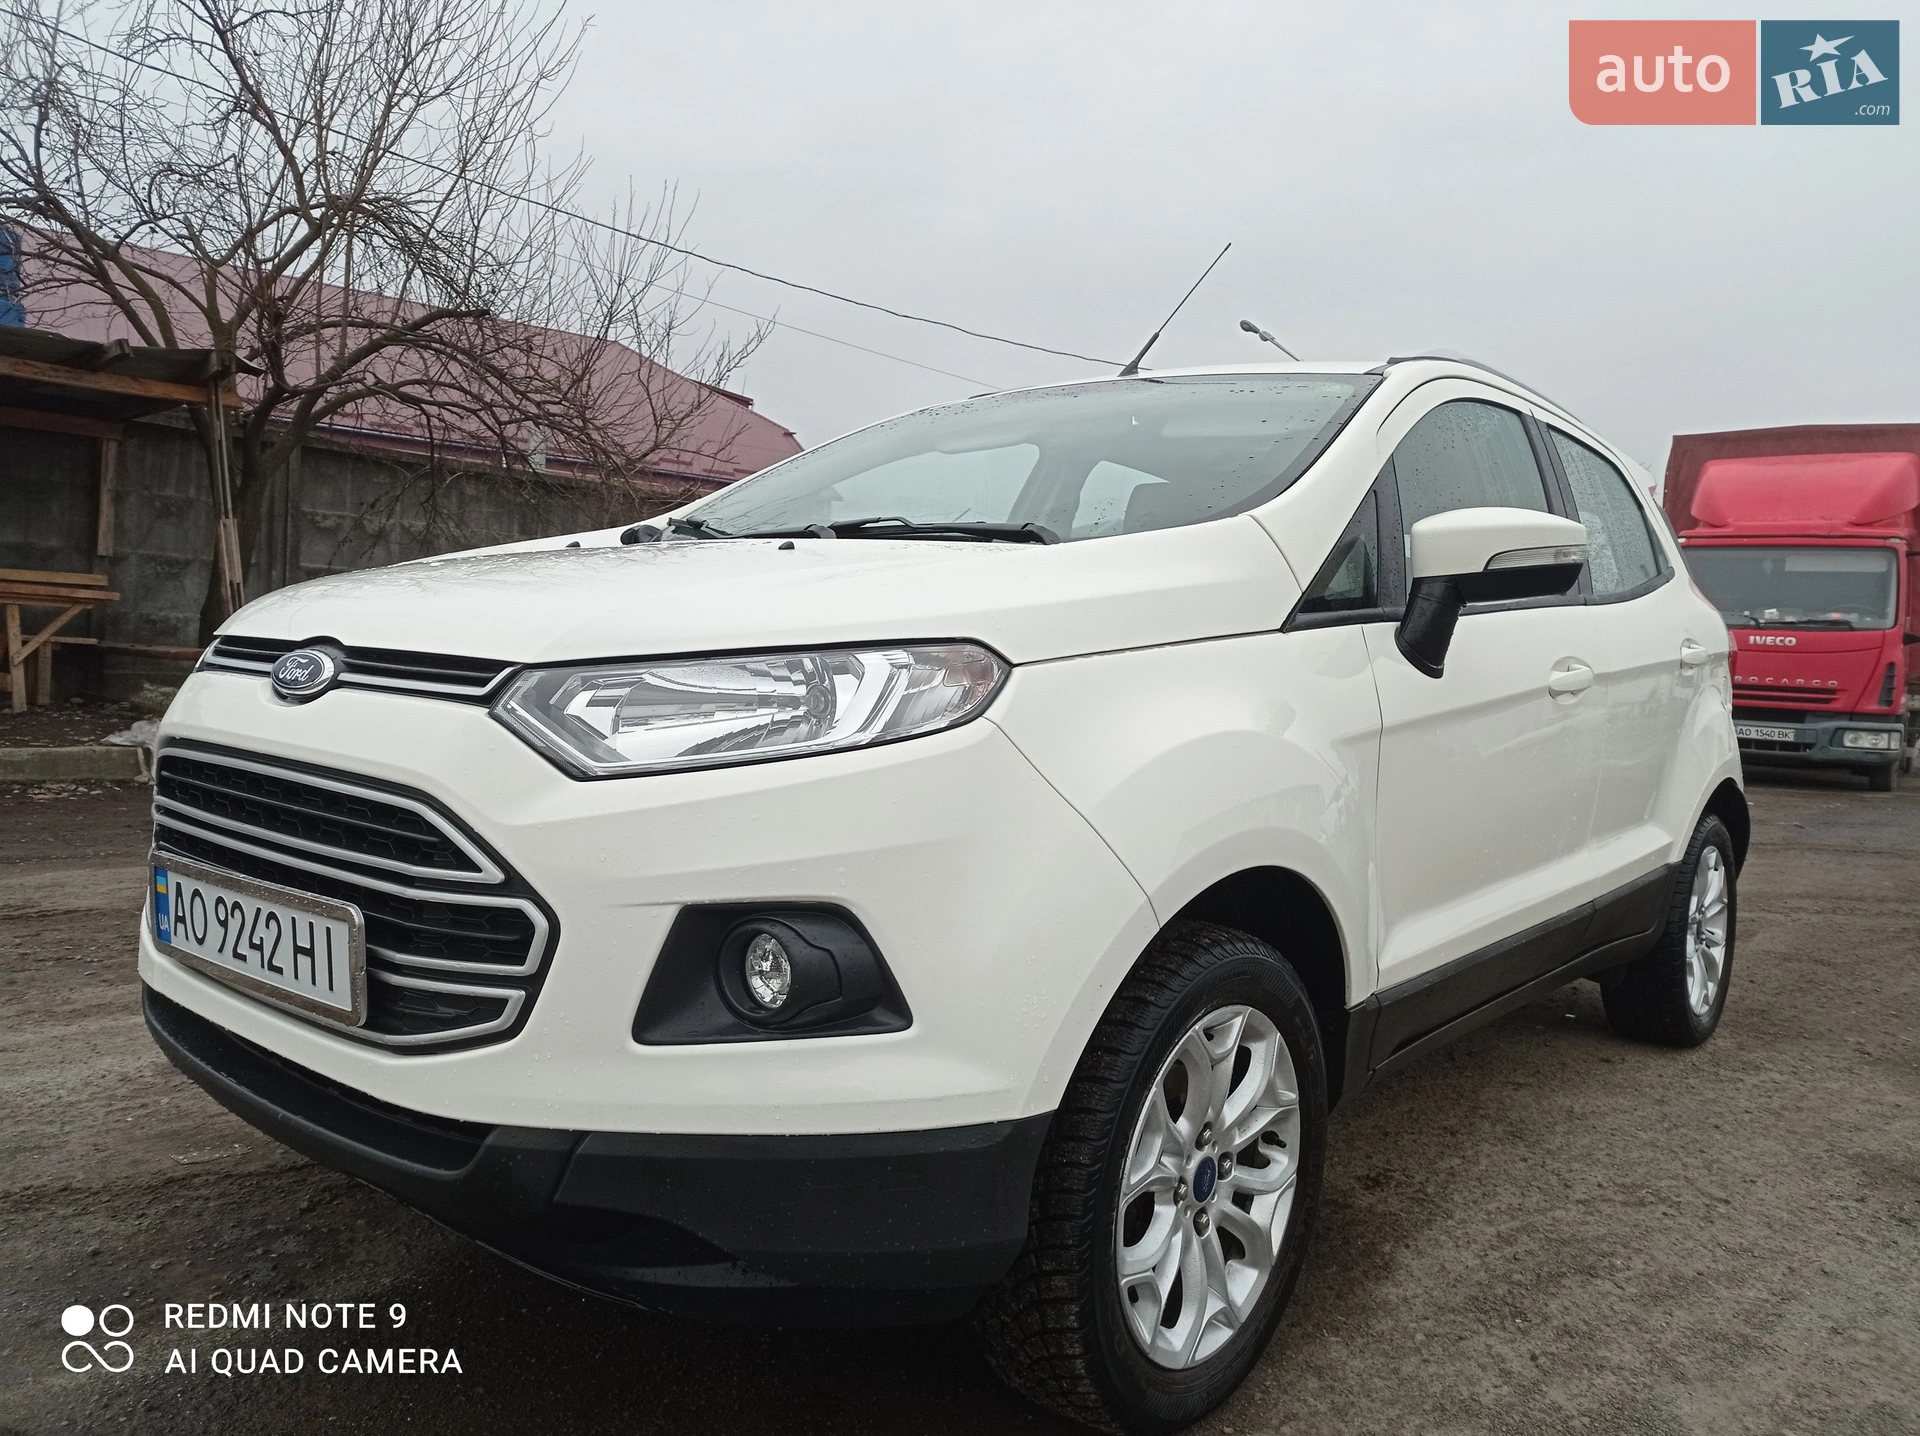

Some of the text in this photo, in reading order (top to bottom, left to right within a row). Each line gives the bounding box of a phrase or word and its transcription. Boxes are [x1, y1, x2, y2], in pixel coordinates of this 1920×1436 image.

[1749, 635, 1797, 646] IVECO
[278, 656, 315, 682] Ford
[1734, 675, 1838, 687] ROCARGO
[1738, 728, 1791, 739] AO 1540 BK
[158, 912, 170, 932] UA
[173, 881, 334, 992] AO 9242 HI
